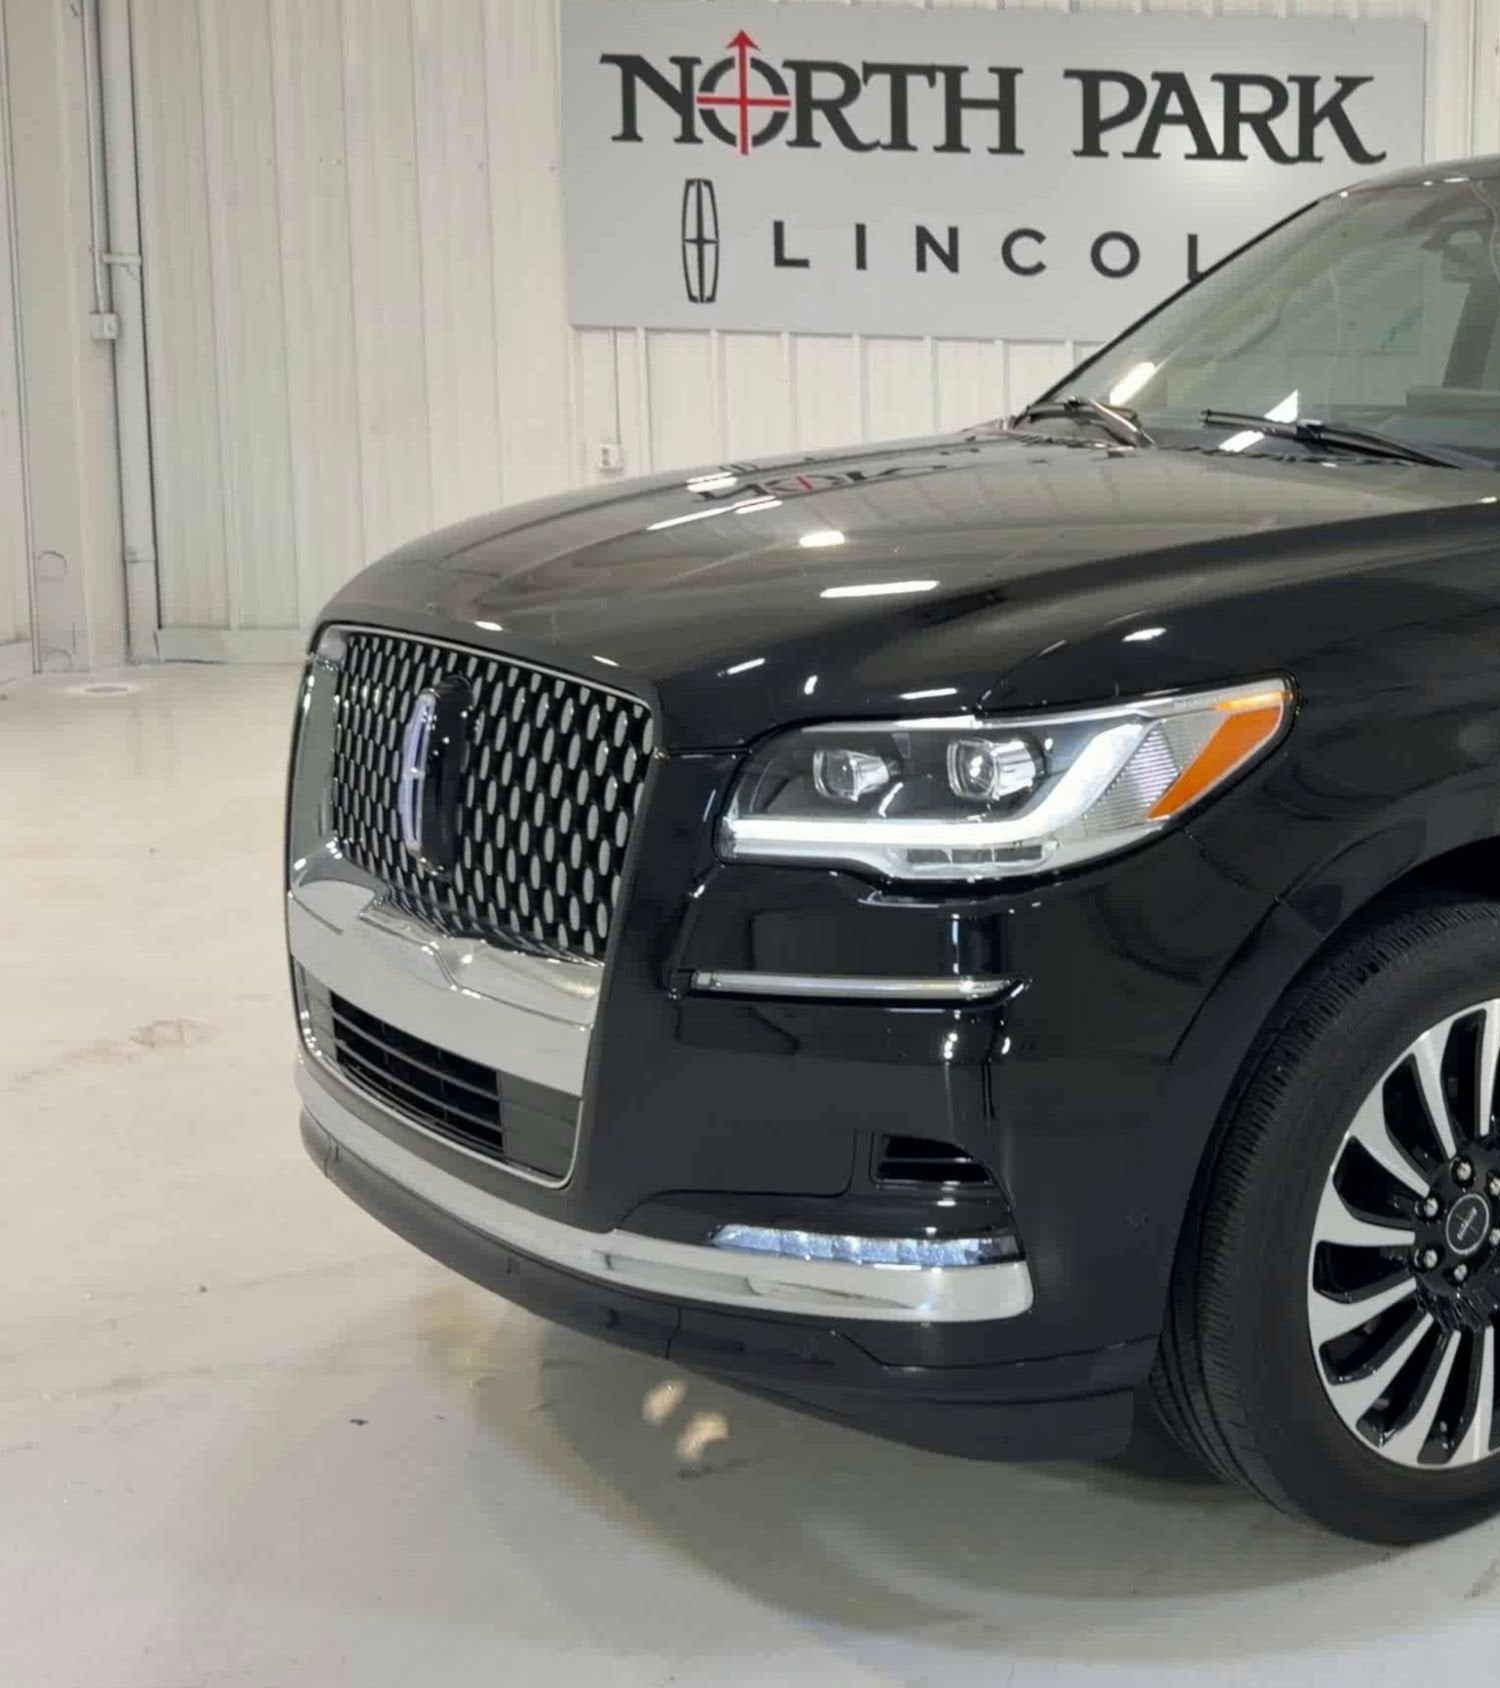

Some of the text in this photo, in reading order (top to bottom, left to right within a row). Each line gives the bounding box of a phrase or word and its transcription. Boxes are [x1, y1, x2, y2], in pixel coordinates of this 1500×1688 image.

[599, 52, 1388, 166] NORTH PARK
[772, 219, 1206, 283] LINCOL
